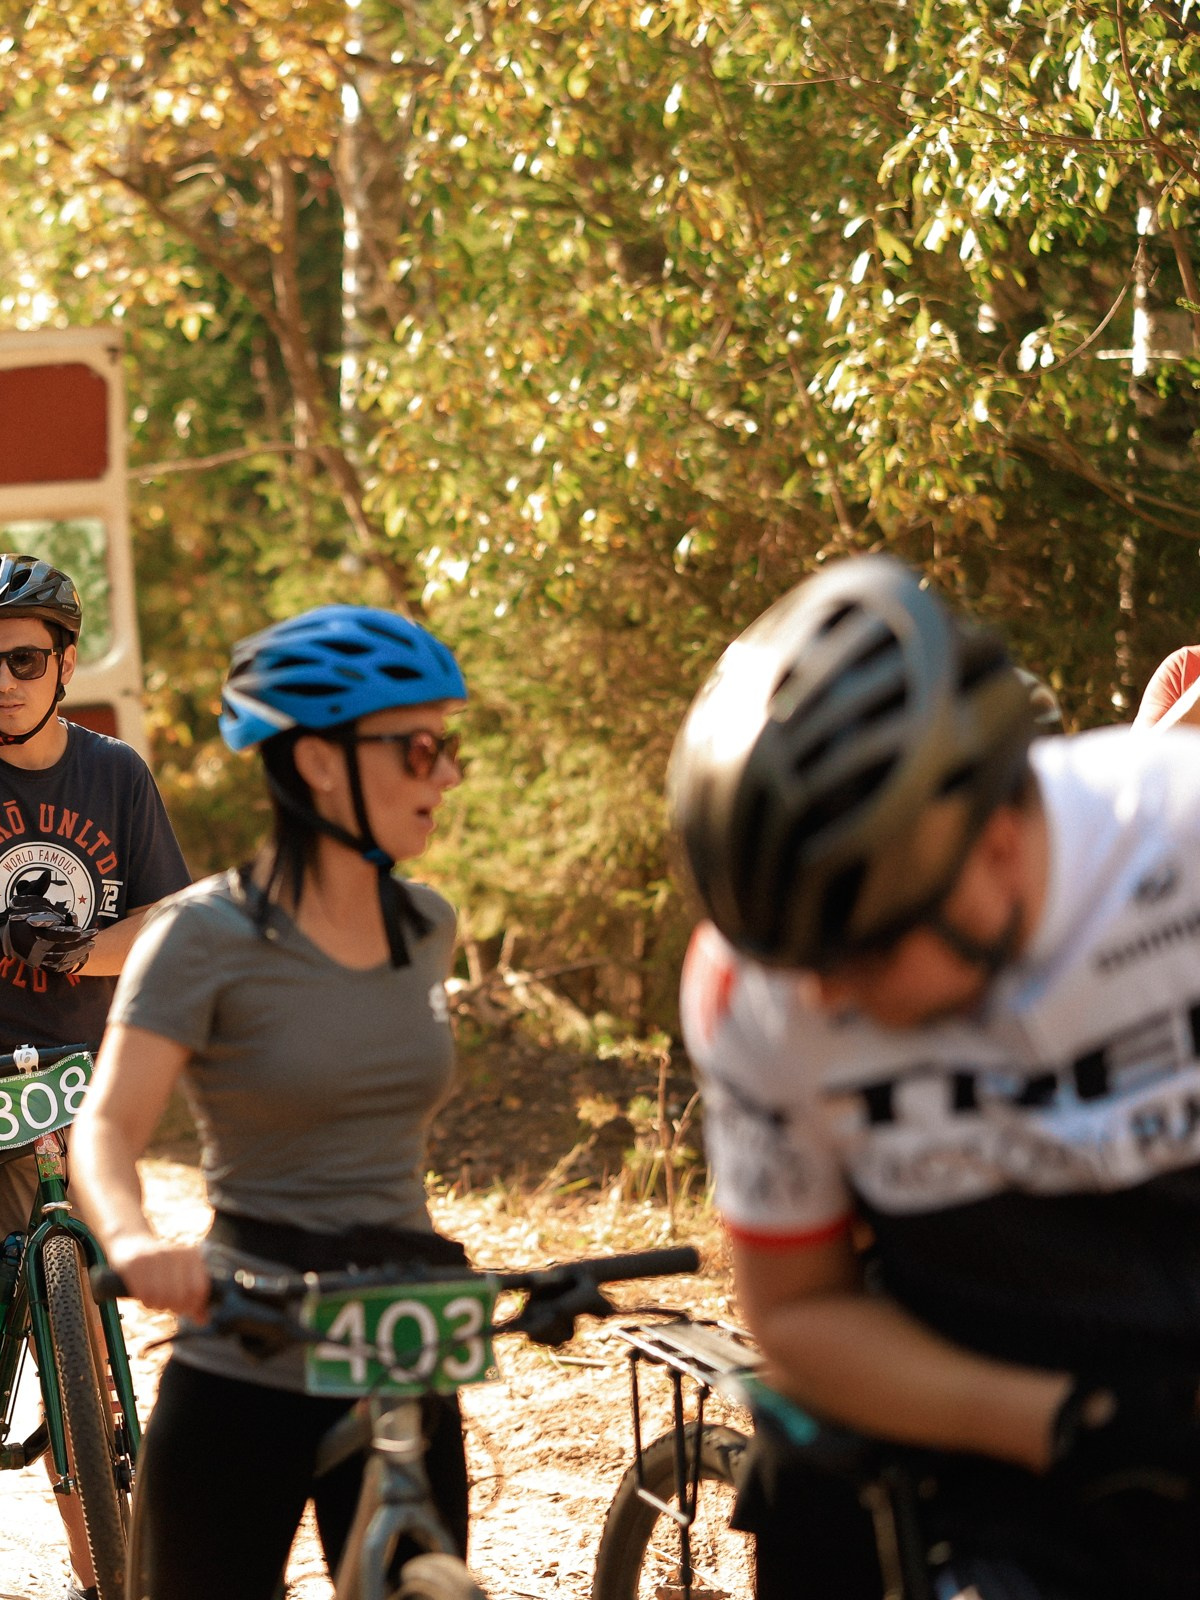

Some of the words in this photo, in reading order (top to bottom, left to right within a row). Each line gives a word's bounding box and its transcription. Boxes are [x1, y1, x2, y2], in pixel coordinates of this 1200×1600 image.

[2, 850, 34, 873] WORLD
[38, 849, 78, 876] FAMOUS
[39, 803, 118, 875] UNLTD
[99, 884, 120, 913] 72
[312, 1296, 486, 1385] 403
